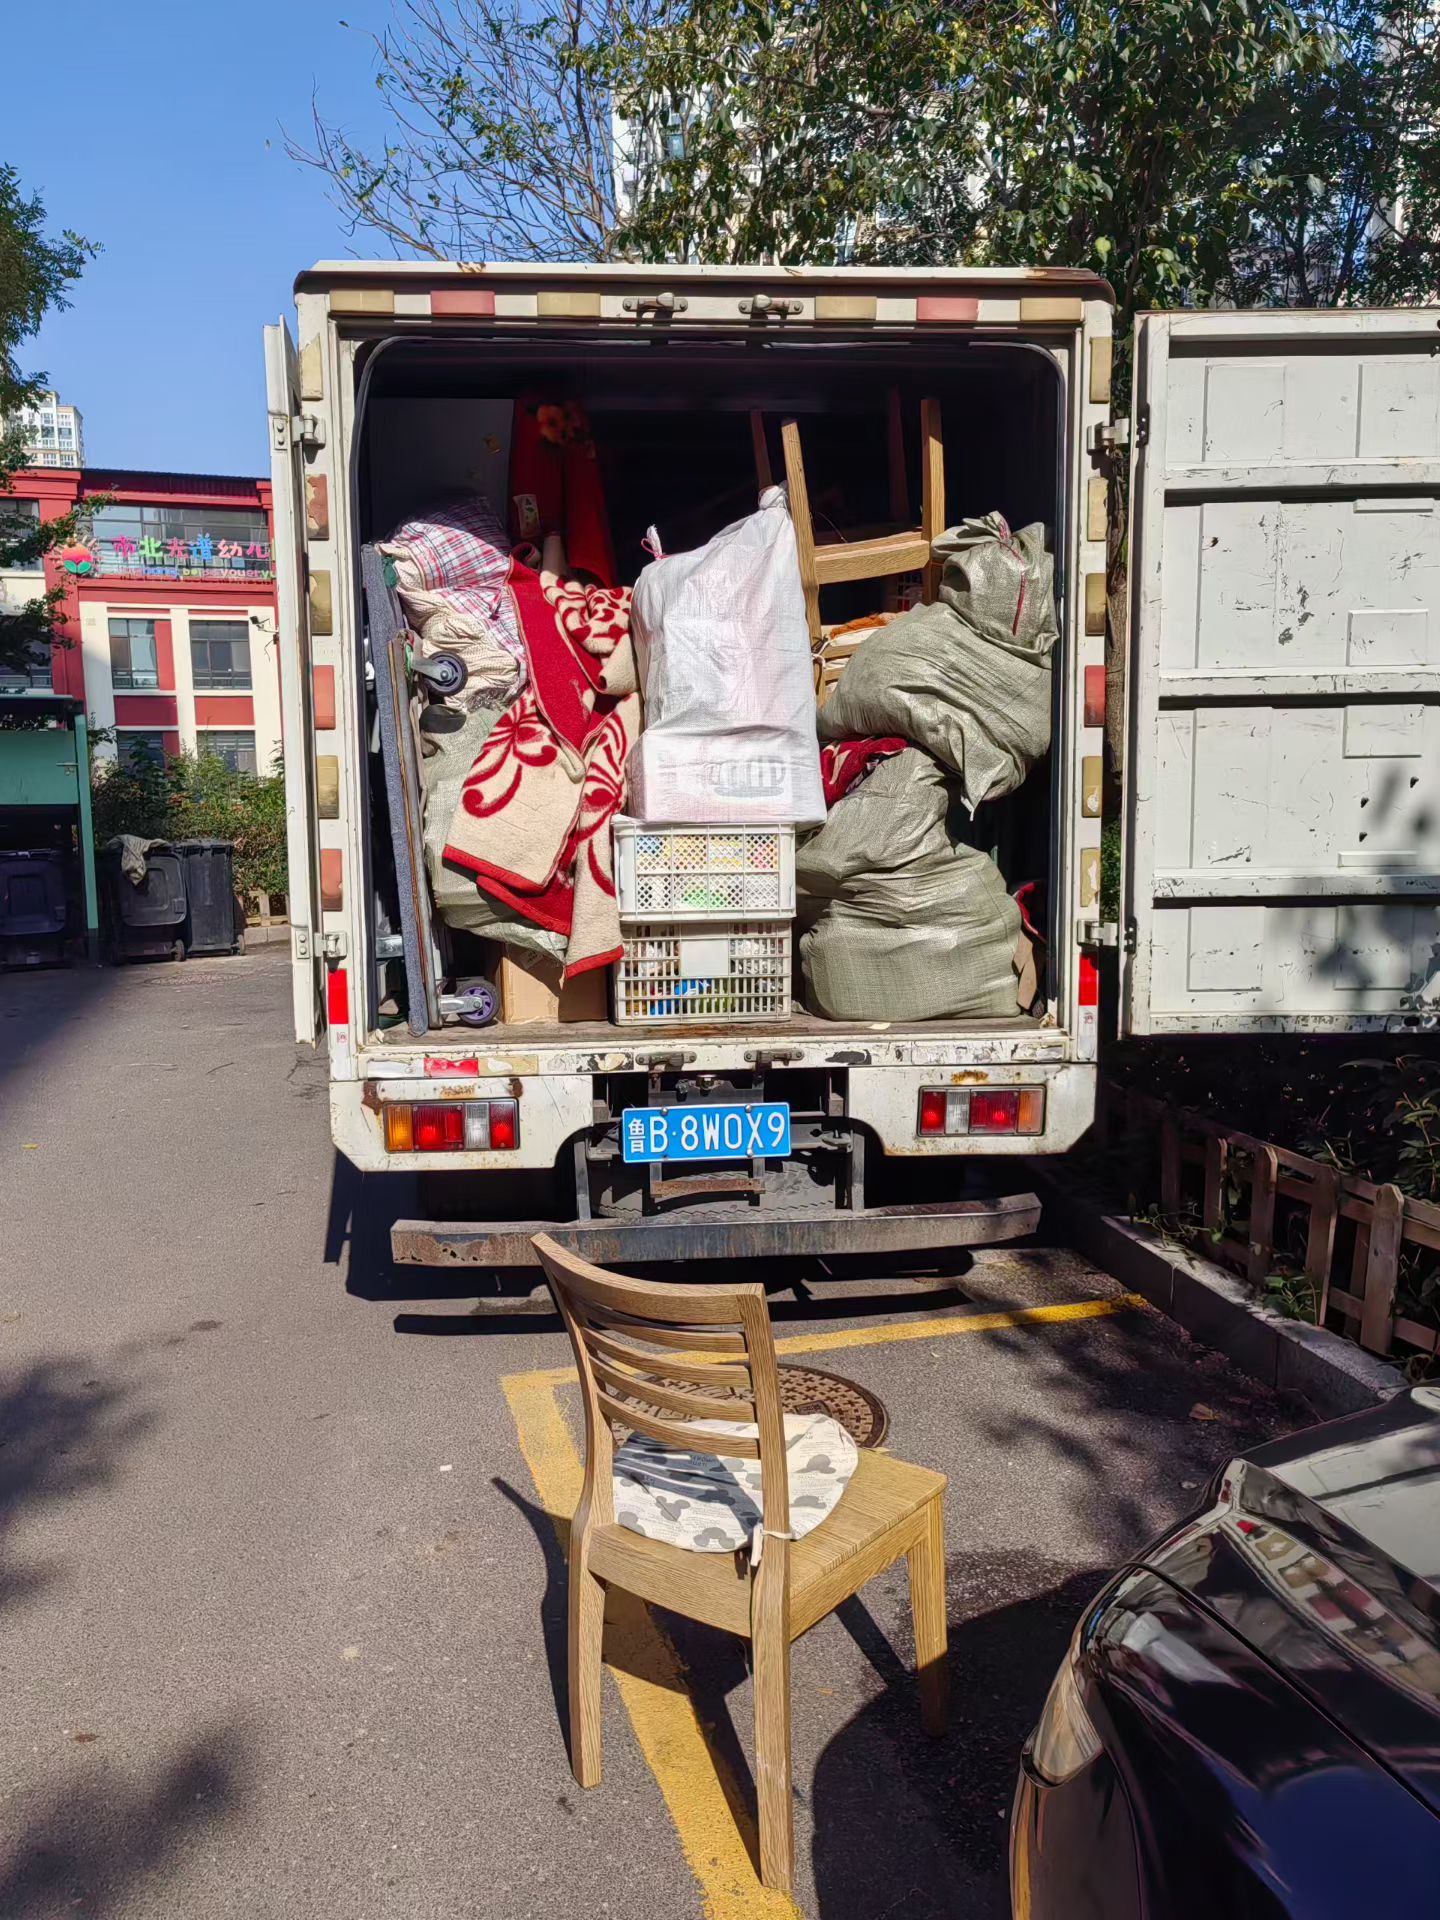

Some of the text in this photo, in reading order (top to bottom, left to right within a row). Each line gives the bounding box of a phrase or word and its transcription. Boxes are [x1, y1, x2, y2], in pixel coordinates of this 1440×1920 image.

[114, 533, 275, 561] 市北光谱幼儿
